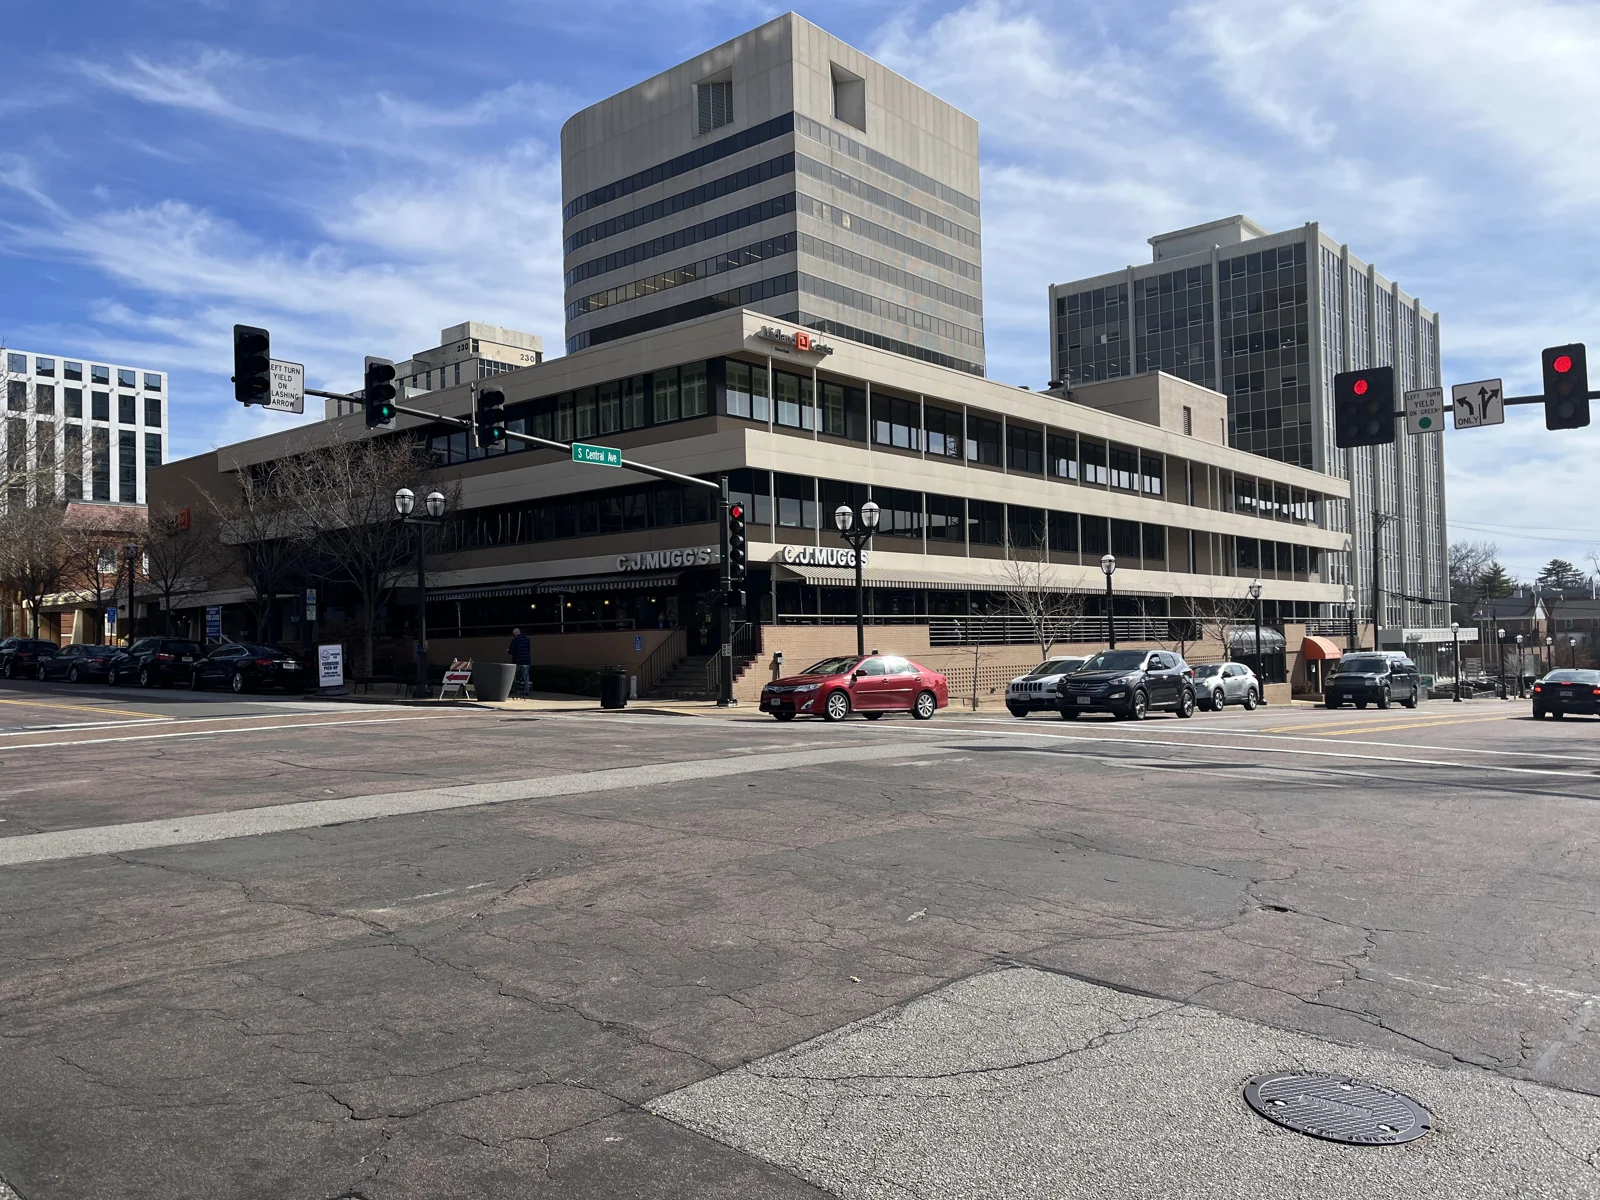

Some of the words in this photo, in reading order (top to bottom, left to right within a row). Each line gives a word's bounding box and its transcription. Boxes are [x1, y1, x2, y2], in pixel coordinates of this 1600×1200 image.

[457, 343, 469, 352] 230
[520, 354, 535, 363] 230
[270, 363, 282, 372] EFT
[284, 365, 301, 375] TURN
[273, 372, 293, 382] YIELD
[278, 382, 288, 390] ON
[271, 389, 299, 400] LASHING
[271, 398, 295, 408] ARROW
[1414, 399, 1435, 408] YIELD
[1458, 416, 1478, 426] ONLY
[577, 447, 583, 459] S
[585, 448, 605, 461] Central
[607, 451, 617, 463] Ave
[784, 545, 869, 569] C.J.MUGGS
